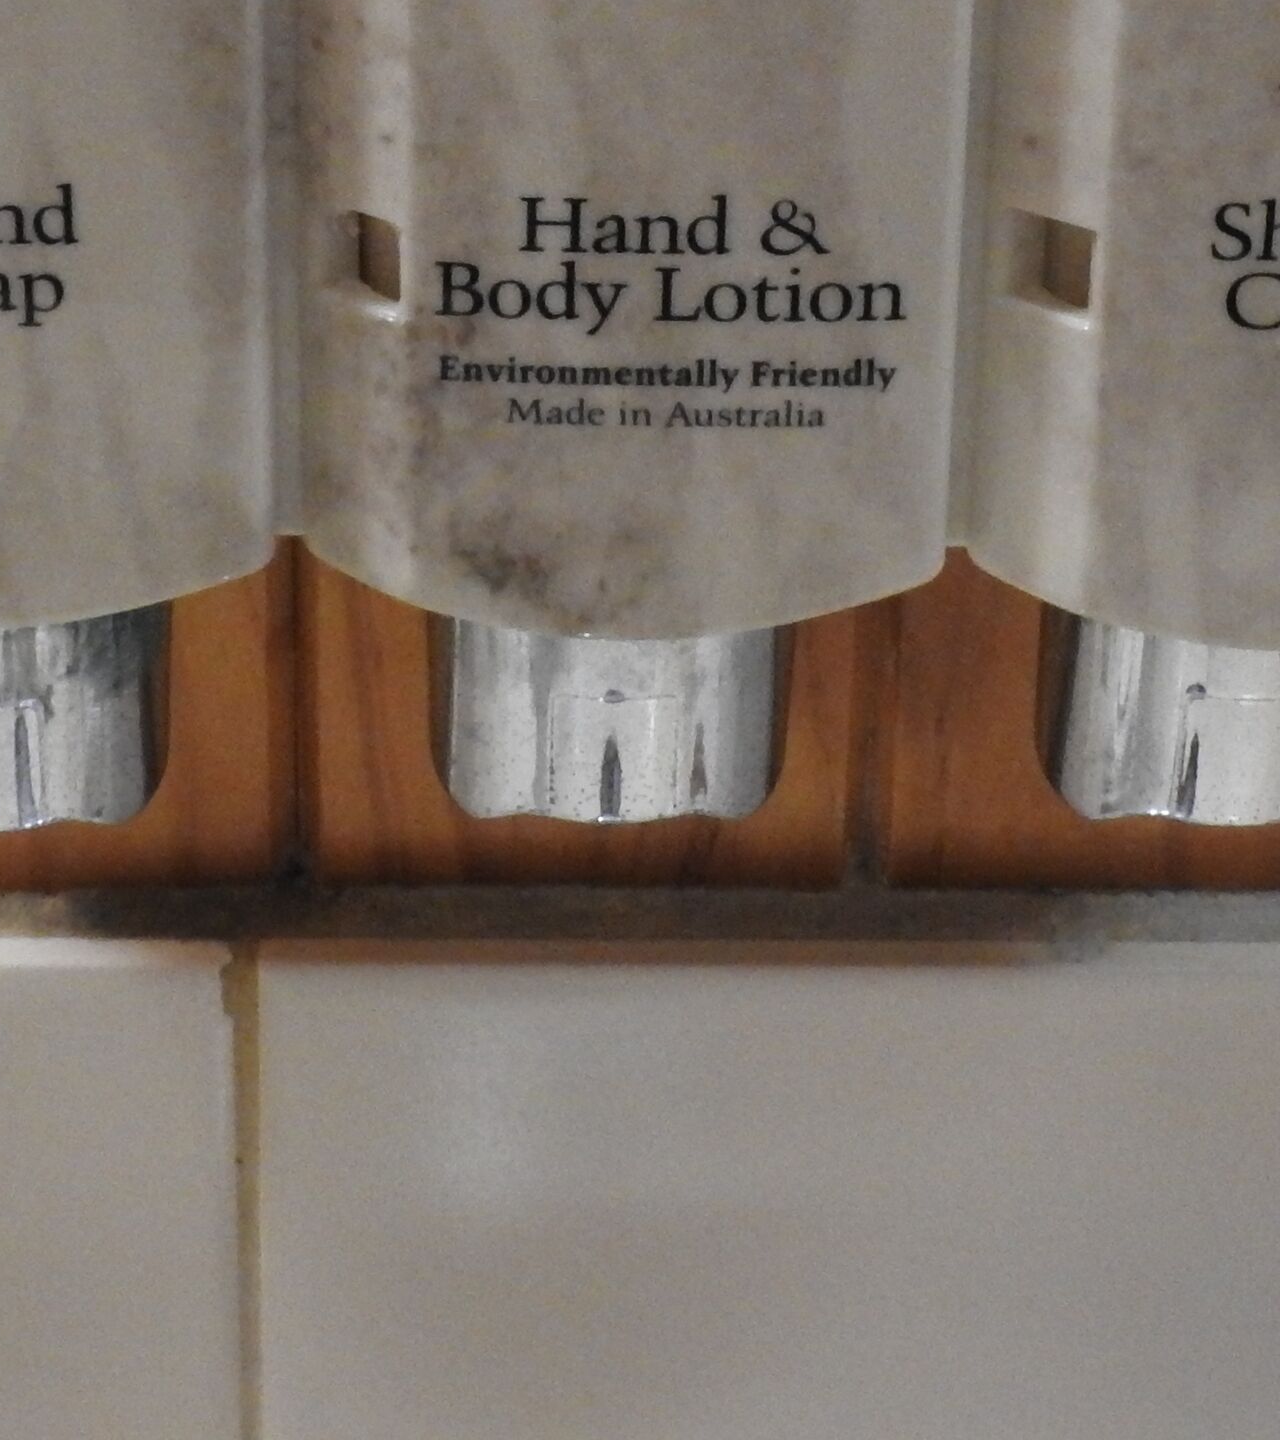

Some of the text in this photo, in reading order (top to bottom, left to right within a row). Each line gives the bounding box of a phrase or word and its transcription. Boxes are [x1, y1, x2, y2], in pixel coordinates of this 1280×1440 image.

[519, 193, 831, 257] Hand &
[434, 259, 907, 336] Body Lotion
[438, 354, 897, 393] Environmentally Friendly
[507, 397, 826, 429] Made in Australia
